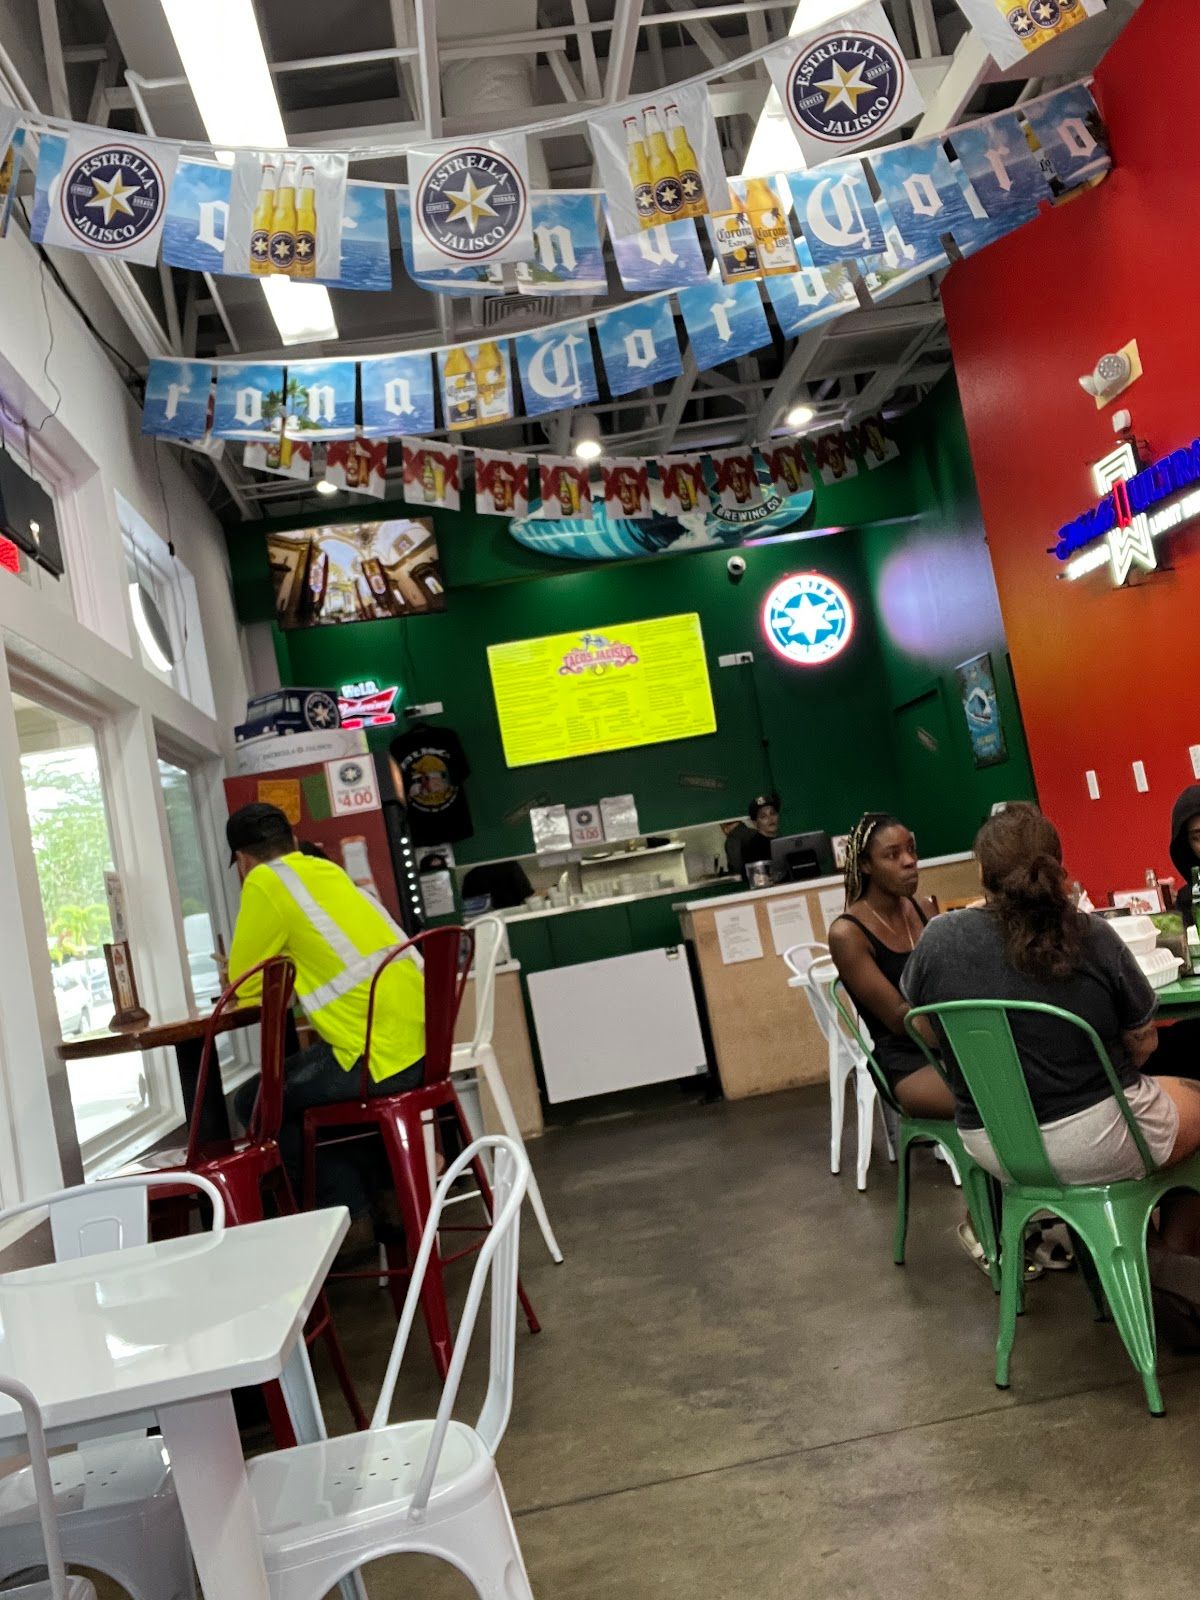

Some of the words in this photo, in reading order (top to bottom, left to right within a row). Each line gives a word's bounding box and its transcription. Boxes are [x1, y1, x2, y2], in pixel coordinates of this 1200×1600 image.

[796, 39, 876, 87] ESTRELLA
[824, 96, 889, 134] JALISCO
[80, 153, 155, 190] ESTRELLA
[428, 155, 509, 192] ESTRELLA
[74, 215, 136, 242] JALISCO
[440, 226, 505, 250] JALISCO
[717, 506, 768, 522] BREWING
